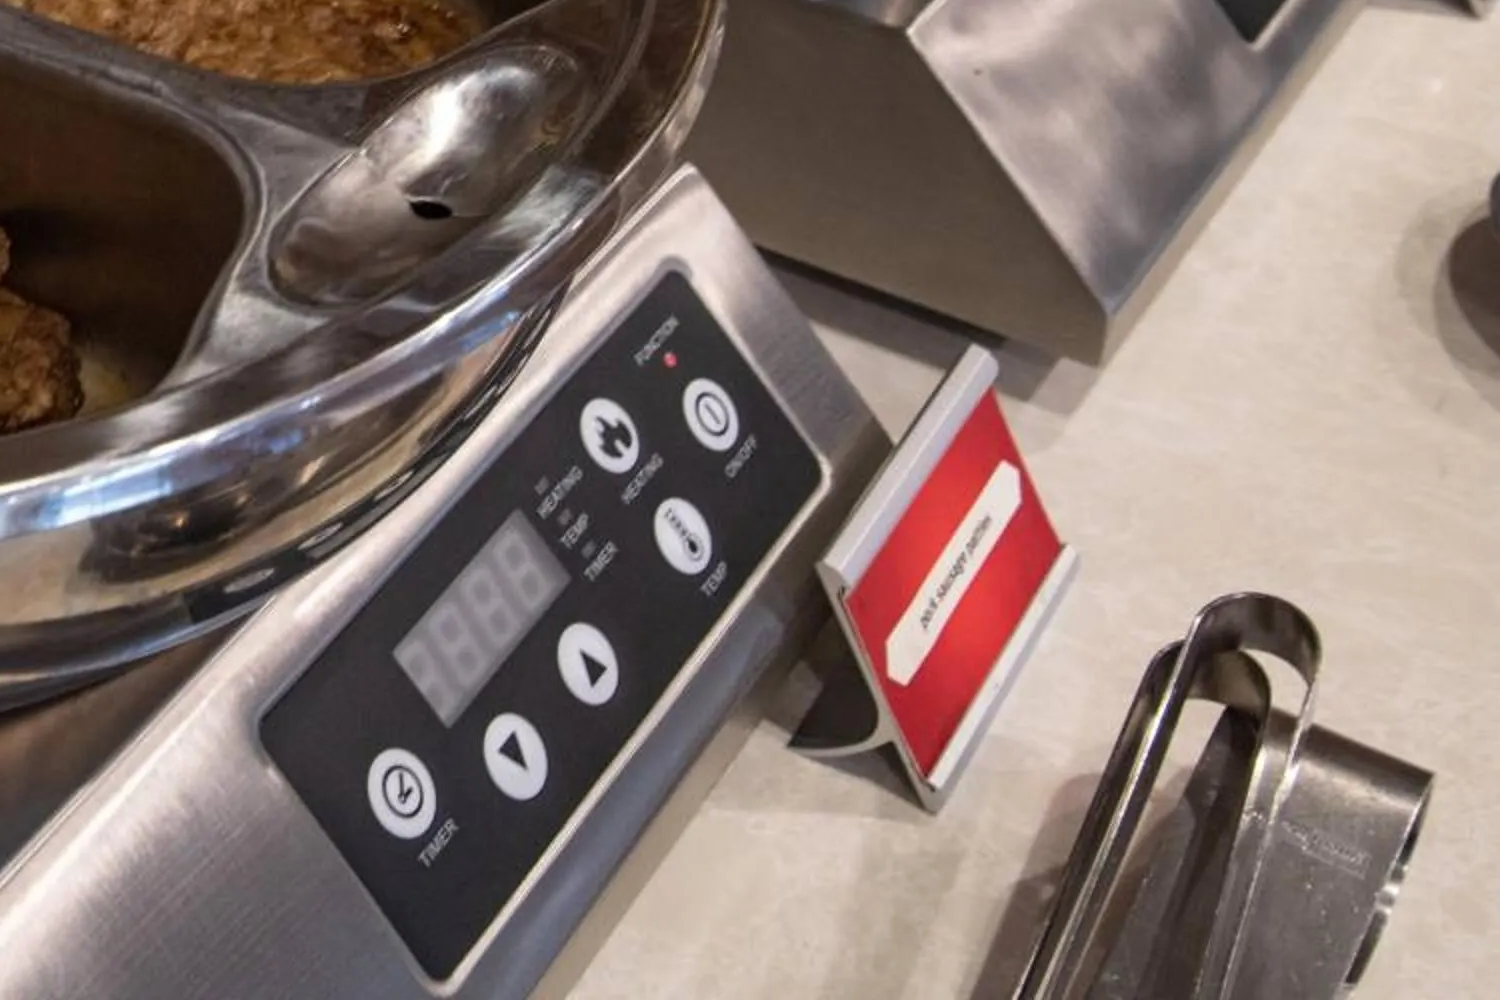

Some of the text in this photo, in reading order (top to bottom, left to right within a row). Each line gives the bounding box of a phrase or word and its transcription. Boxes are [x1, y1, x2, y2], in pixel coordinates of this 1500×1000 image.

[536, 465, 583, 519] HEATING
[620, 453, 664, 505] HEATING
[560, 512, 589, 549] TEMP
[583, 541, 618, 582] TIMER
[701, 561, 728, 597] TEMP
[416, 817, 460, 869] TIMER
